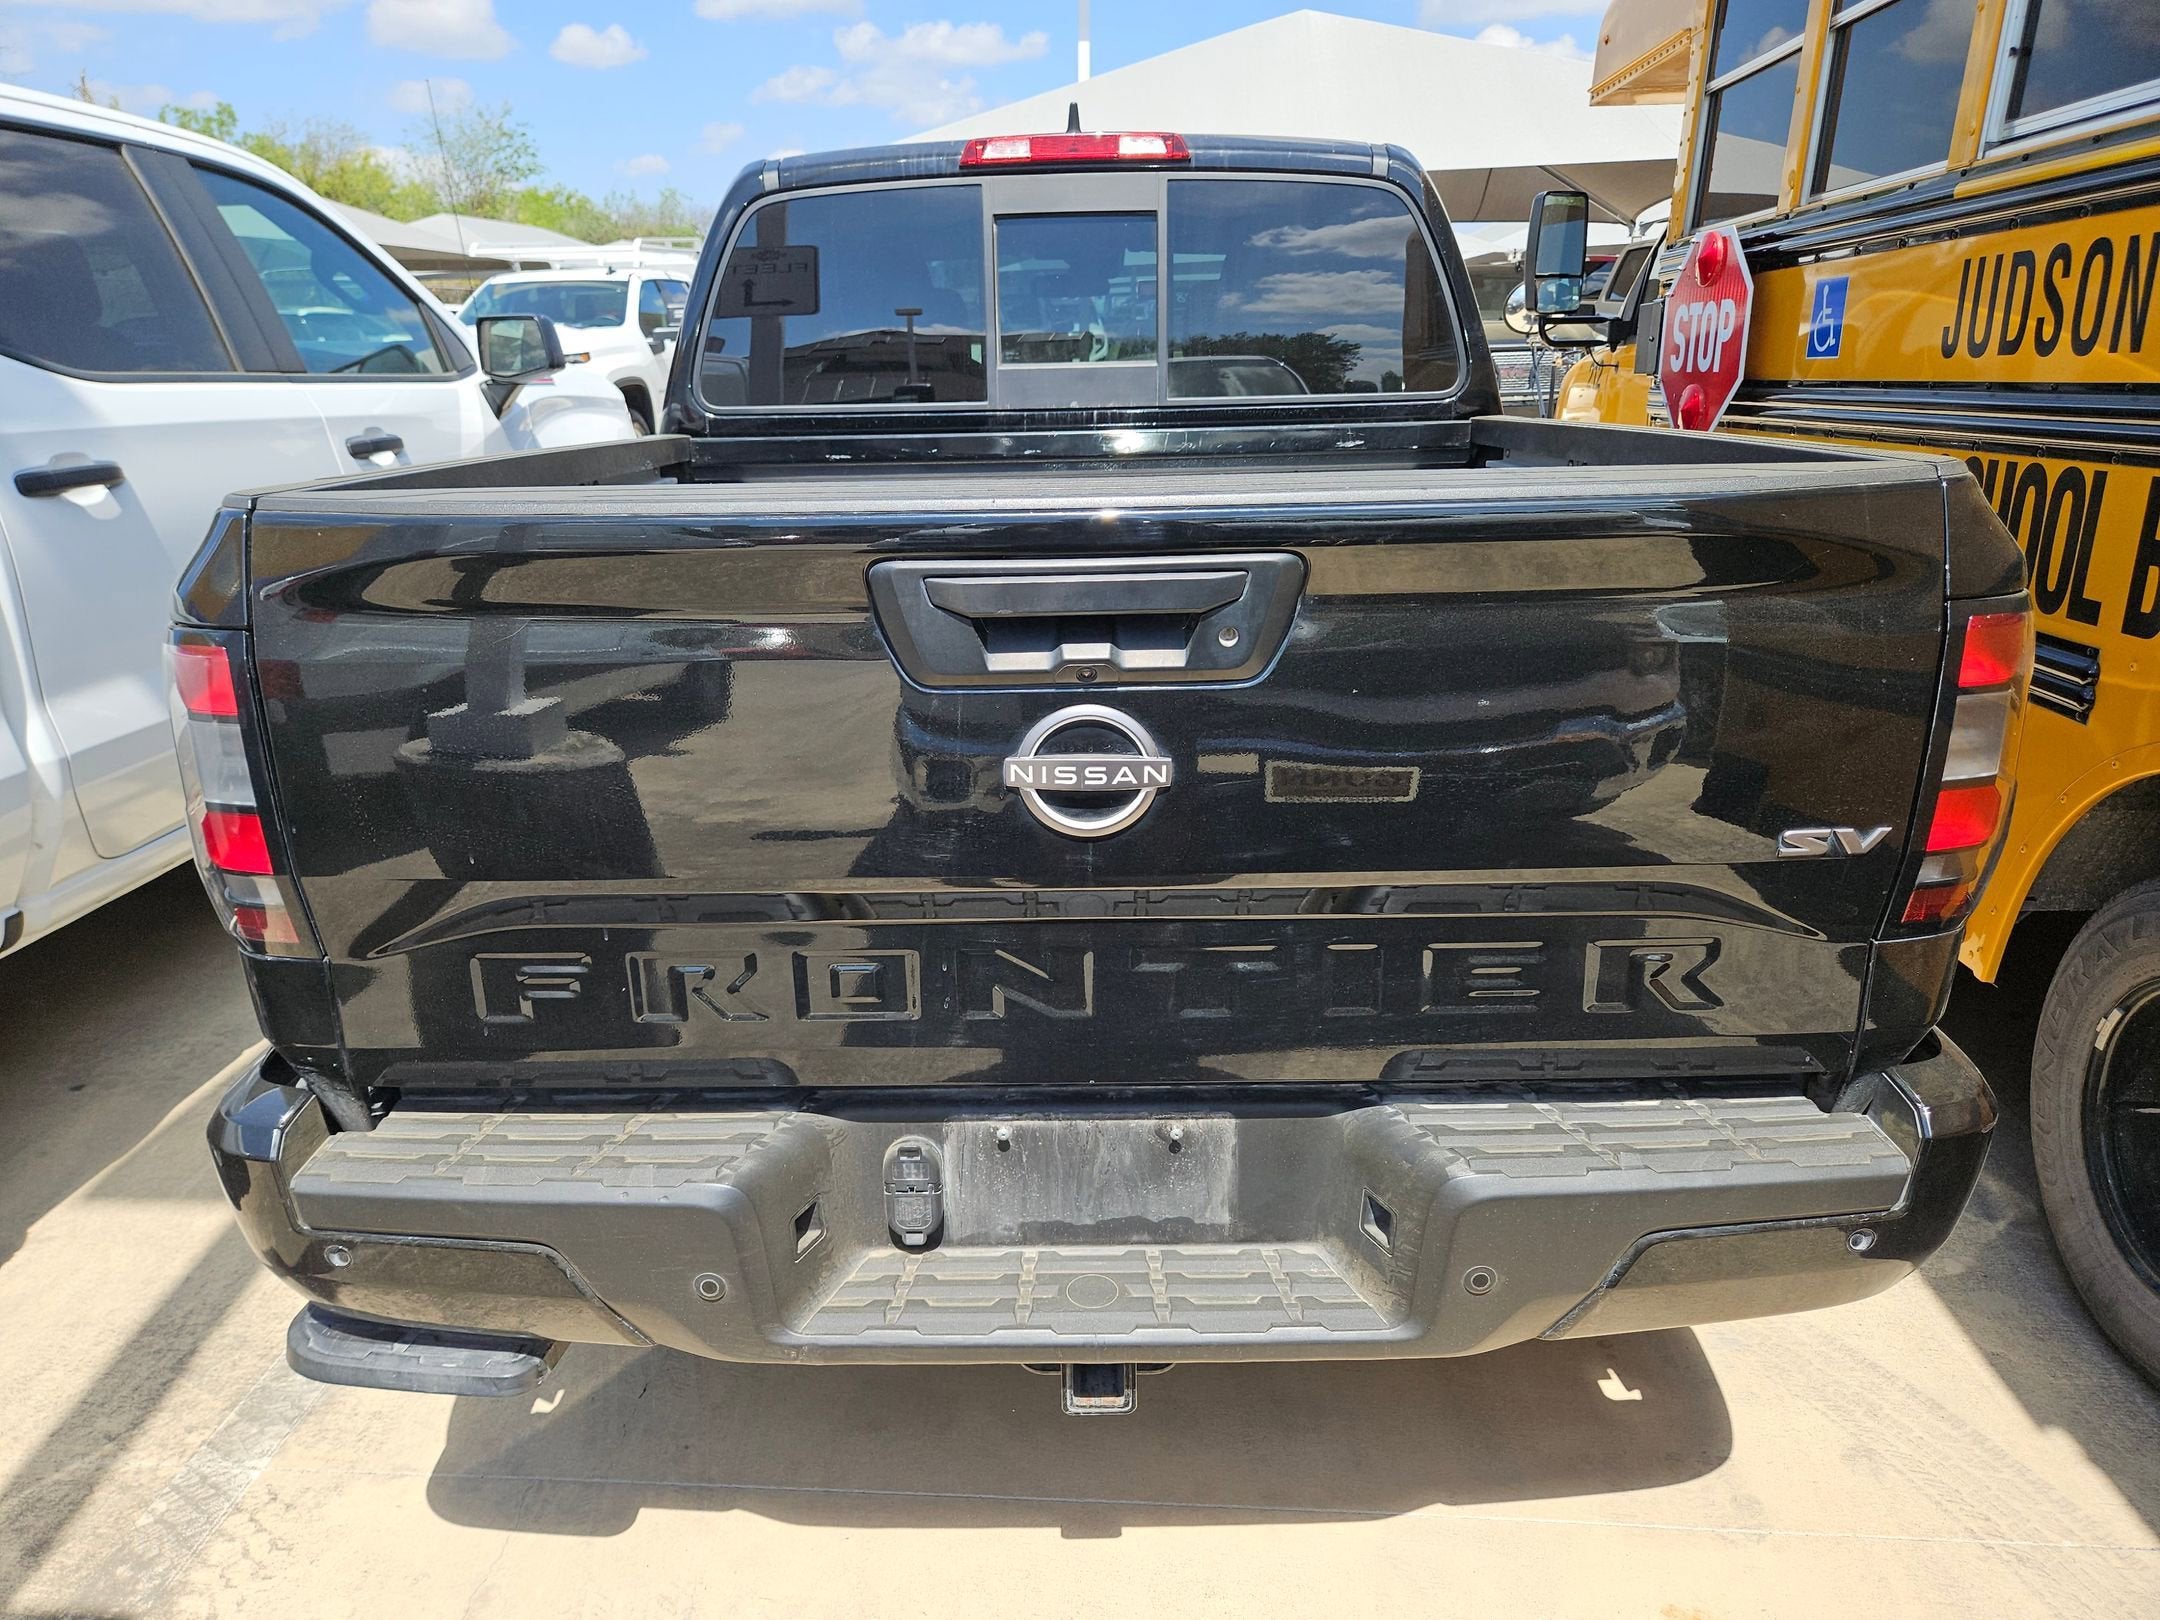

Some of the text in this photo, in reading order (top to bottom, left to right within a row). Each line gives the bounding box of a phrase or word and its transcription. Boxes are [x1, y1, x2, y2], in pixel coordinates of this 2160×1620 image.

[1670, 298, 1736, 373] STOP
[1941, 232, 2160, 359] JUDSON
[1960, 455, 2109, 627] OOL
[1010, 764, 1167, 785] NISSAN
[1776, 826, 1893, 858] SV
[469, 937, 1723, 1022] FRONTIER
